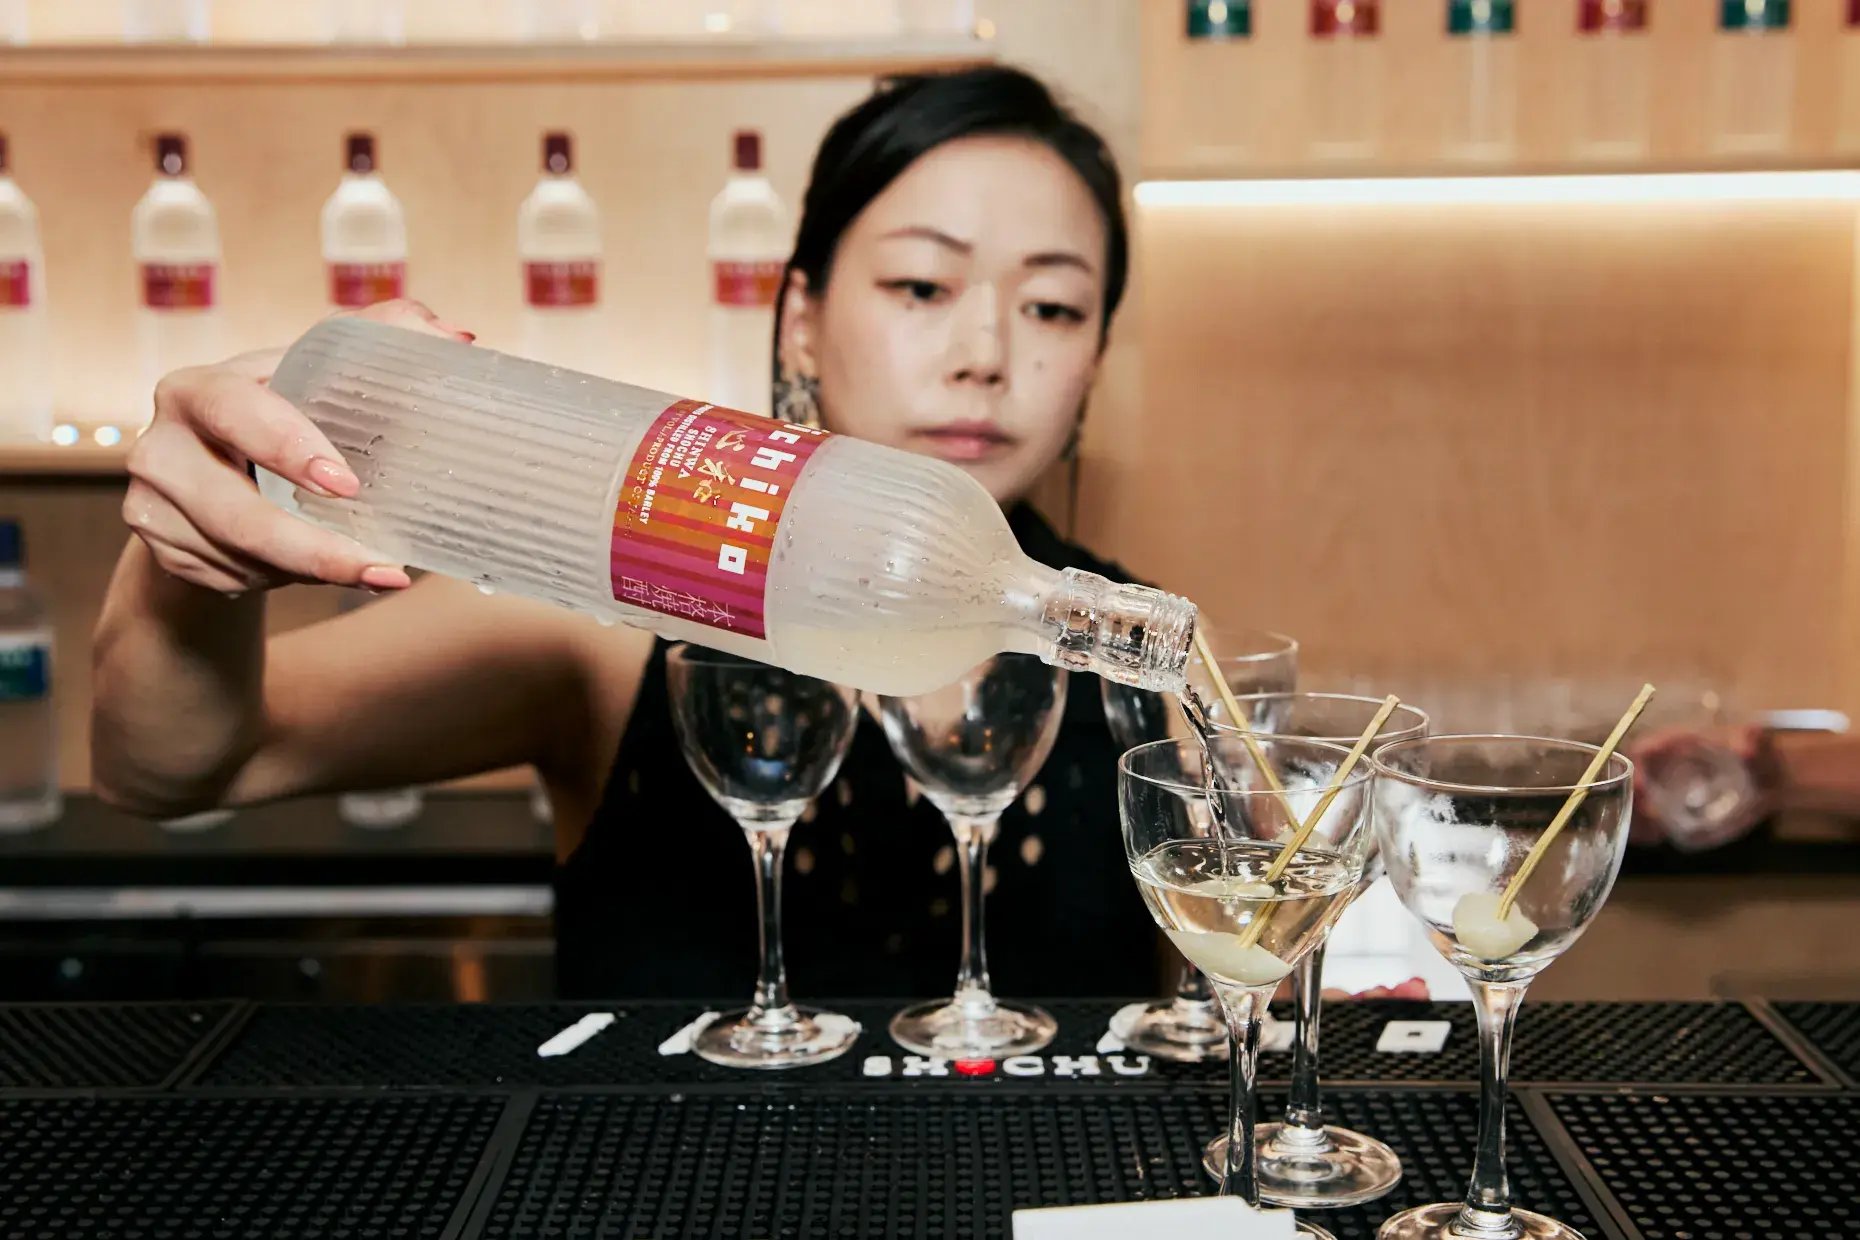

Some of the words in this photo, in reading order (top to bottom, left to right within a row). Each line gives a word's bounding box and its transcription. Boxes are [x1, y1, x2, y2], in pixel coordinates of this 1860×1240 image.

[658, 443, 676, 466] FROM
[669, 429, 699, 468] SHOCHU
[678, 425, 717, 479] SHINWA
[648, 466, 664, 487] 100%
[639, 489, 656, 525] BARLEY
